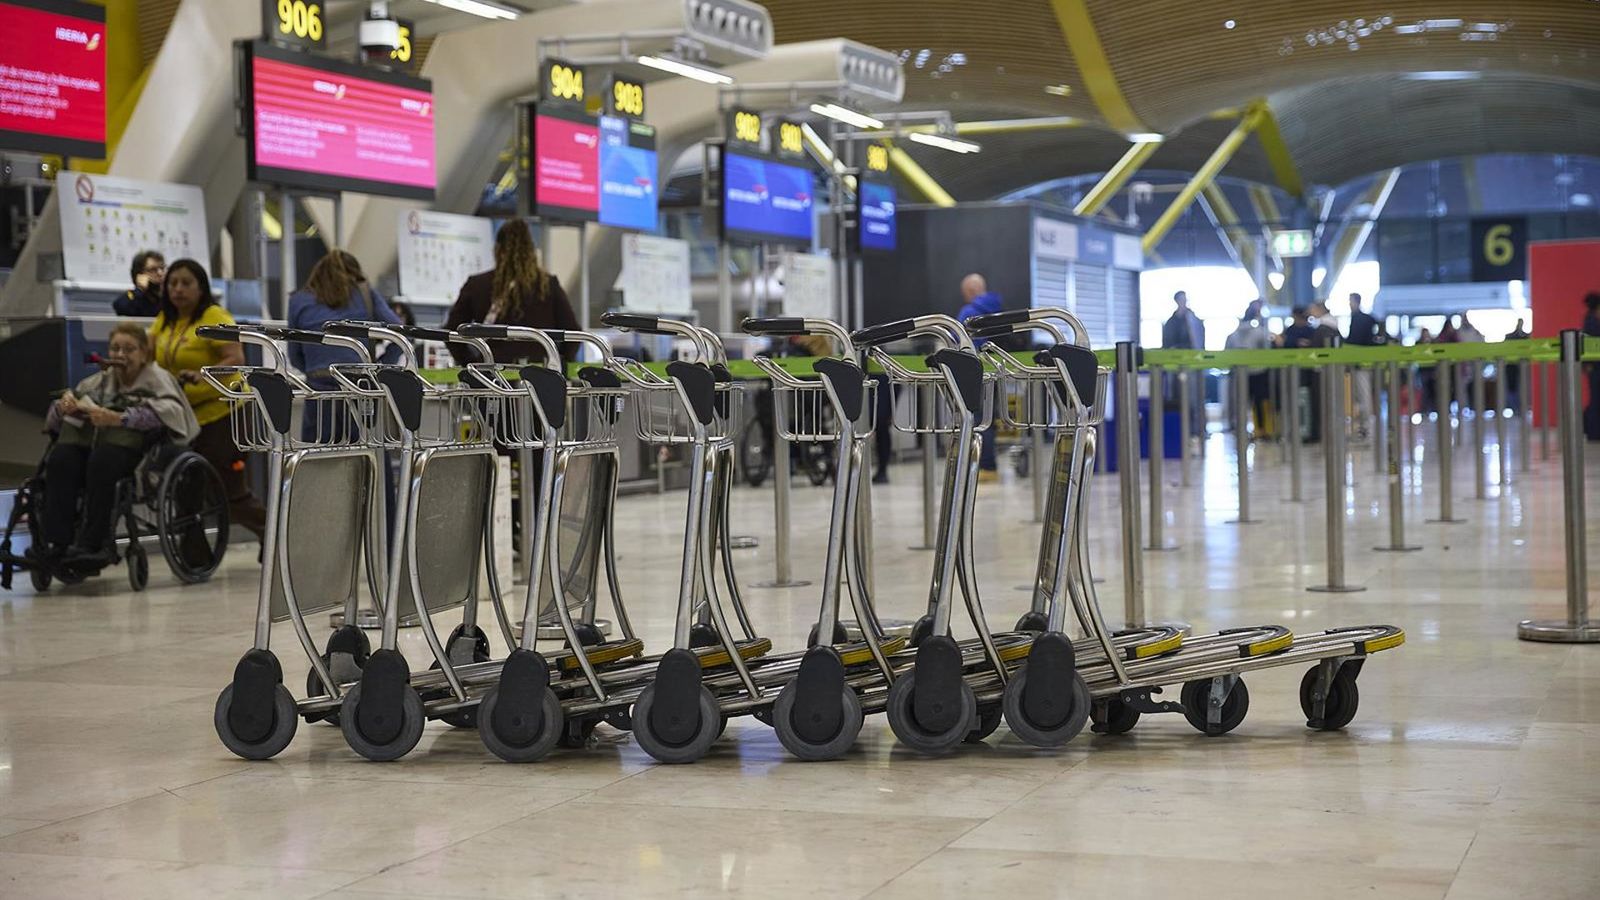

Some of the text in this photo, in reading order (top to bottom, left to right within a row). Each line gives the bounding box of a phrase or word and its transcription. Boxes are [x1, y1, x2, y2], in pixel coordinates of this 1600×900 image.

[55, 26, 88, 44] IBERIA
[278, 0, 322, 41] 906
[551, 64, 584, 101] 904
[614, 80, 644, 116] 903
[735, 111, 761, 142] 902
[1484, 224, 1514, 266] 6
